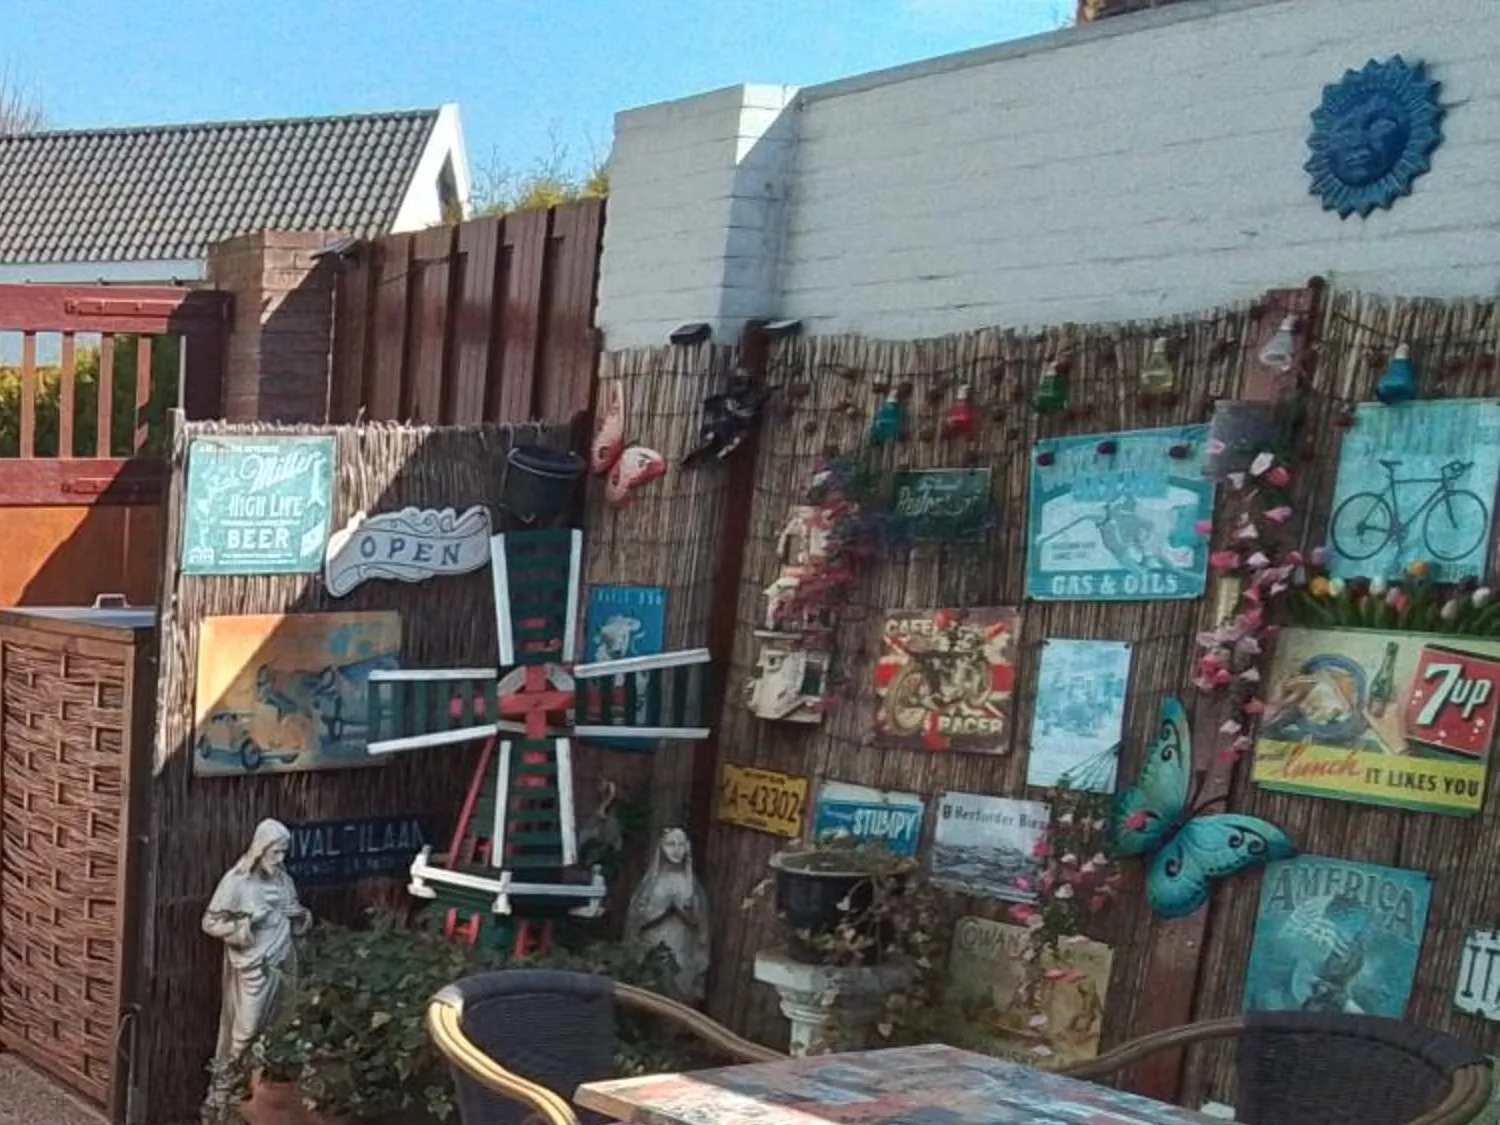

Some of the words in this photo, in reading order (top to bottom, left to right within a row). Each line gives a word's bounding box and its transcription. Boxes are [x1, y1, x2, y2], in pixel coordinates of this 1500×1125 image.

[239, 450, 326, 494] Miller
[227, 526, 291, 550] BEER
[360, 535, 461, 566] OPEN
[1051, 575, 1093, 596] GAS
[1099, 576, 1116, 595] &
[1123, 574, 1179, 596] OILS
[886, 618, 933, 636] CAFE
[1363, 766, 1380, 785] IT
[1387, 769, 1437, 792] LIKES
[1443, 775, 1479, 798] YOU
[1269, 863, 1419, 946] AMERICA
